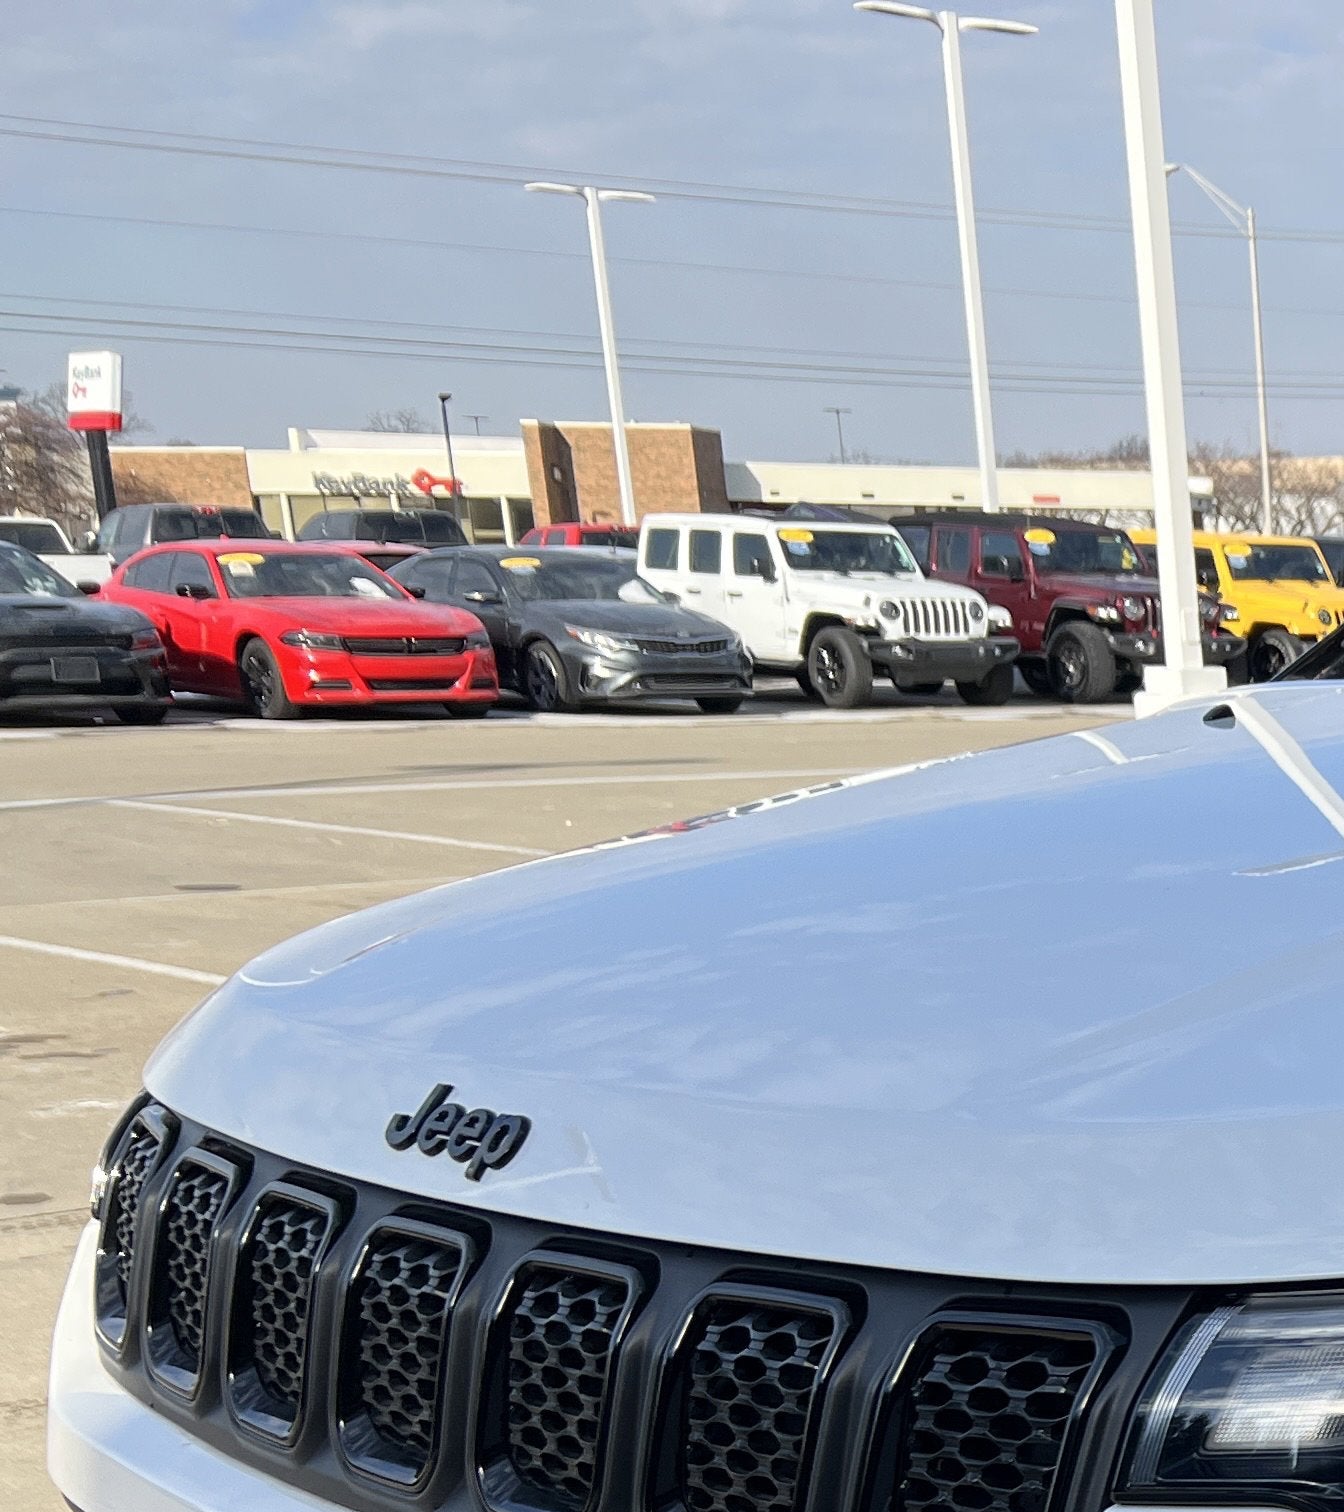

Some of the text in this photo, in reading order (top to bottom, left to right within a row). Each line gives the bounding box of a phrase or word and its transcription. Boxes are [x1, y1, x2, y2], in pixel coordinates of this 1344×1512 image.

[72, 365, 102, 383] KeyBank
[311, 470, 412, 497] KeyBank
[384, 1082, 533, 1182] Jeep
